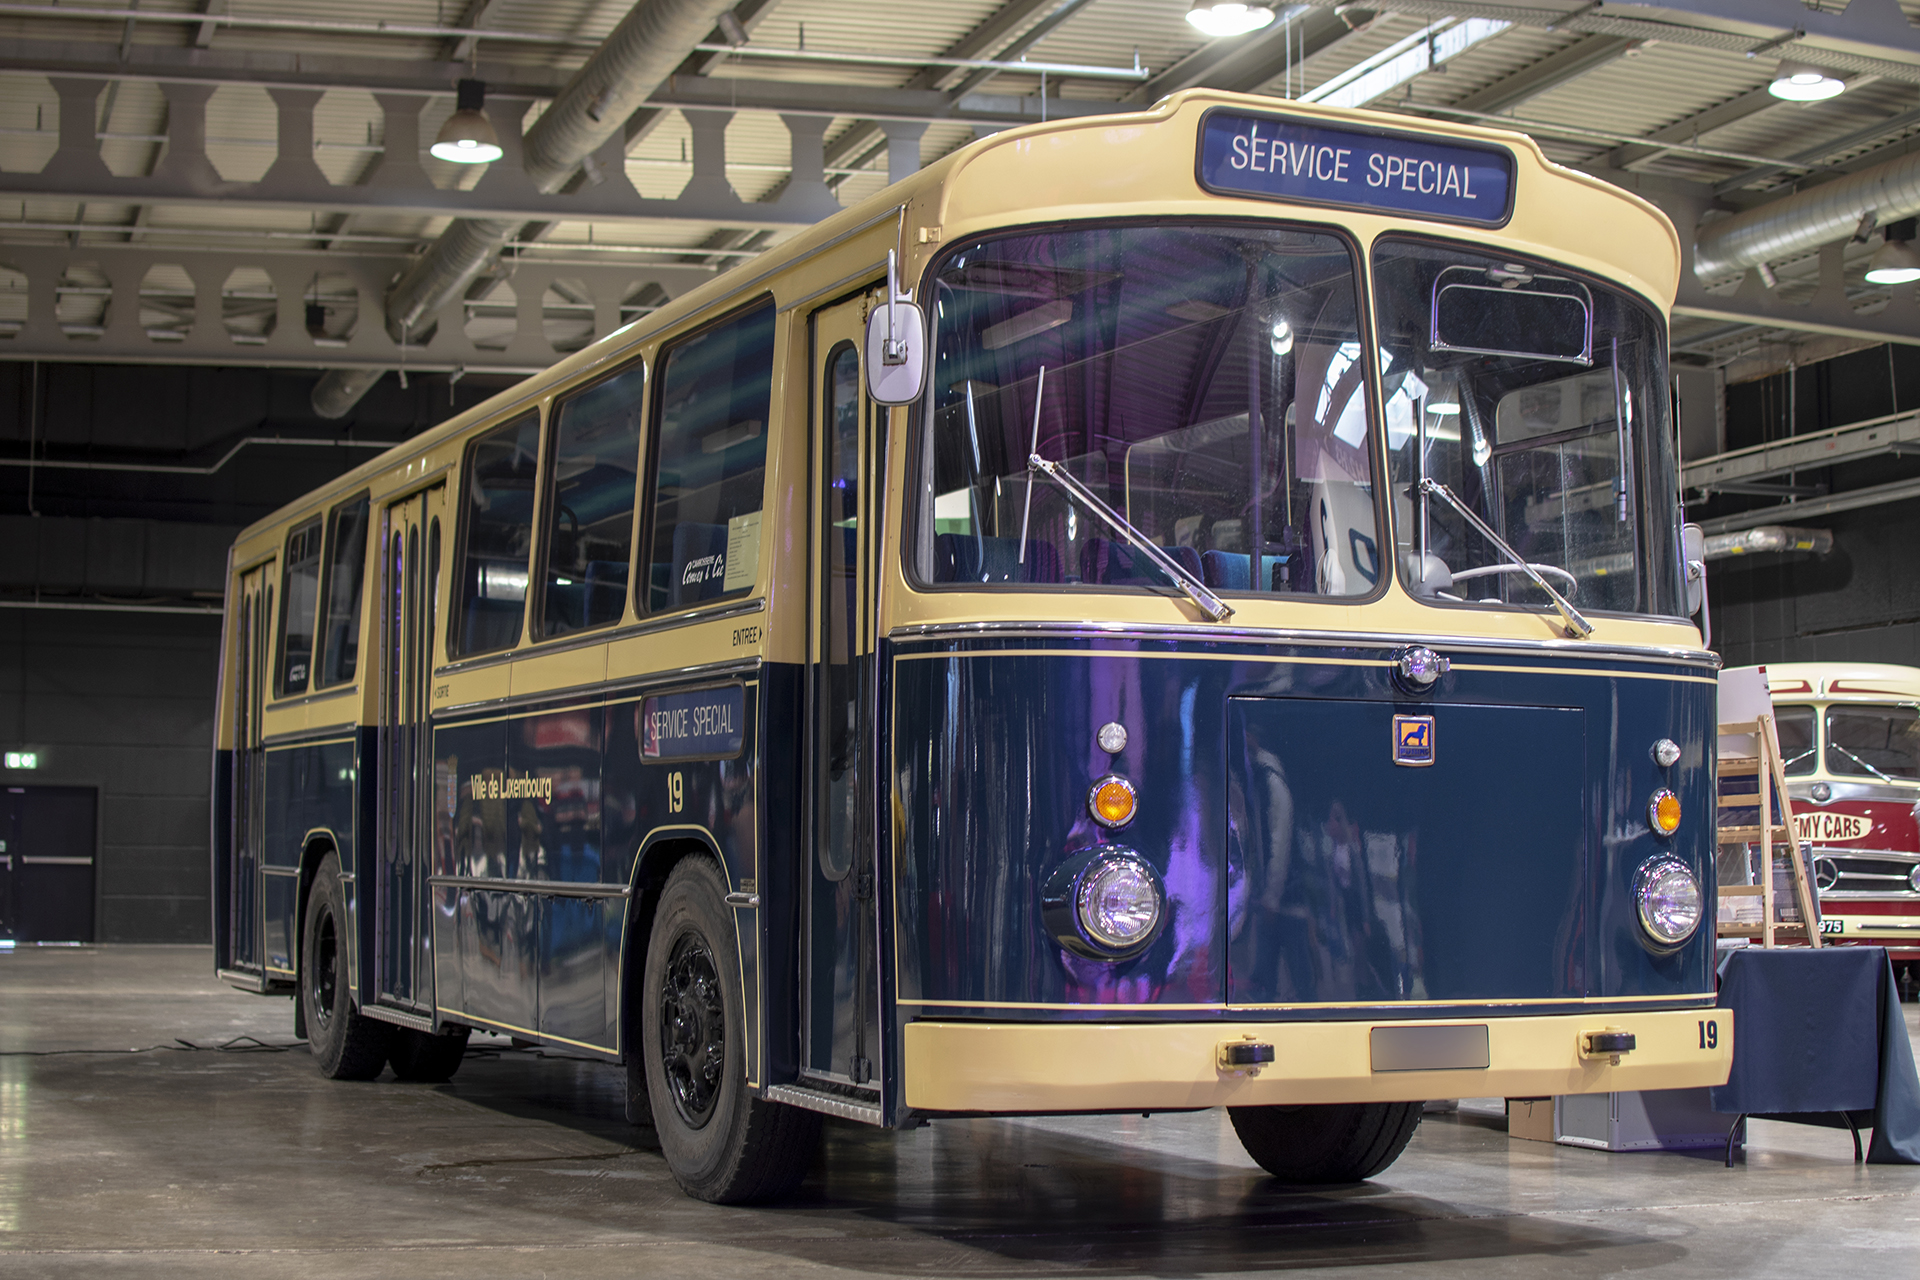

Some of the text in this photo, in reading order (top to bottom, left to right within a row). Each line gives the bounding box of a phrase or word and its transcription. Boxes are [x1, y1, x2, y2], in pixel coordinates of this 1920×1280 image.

[1230, 134, 1477, 199] SERVICE SPECIAL
[732, 626, 757, 647] ENTREE
[650, 704, 734, 741] SERVICE SPECIAL
[470, 770, 552, 805] Ville de Luxembourg
[667, 771, 683, 813] 19
[1824, 815, 1861, 838] CARS
[1698, 1020, 1718, 1049] 19
